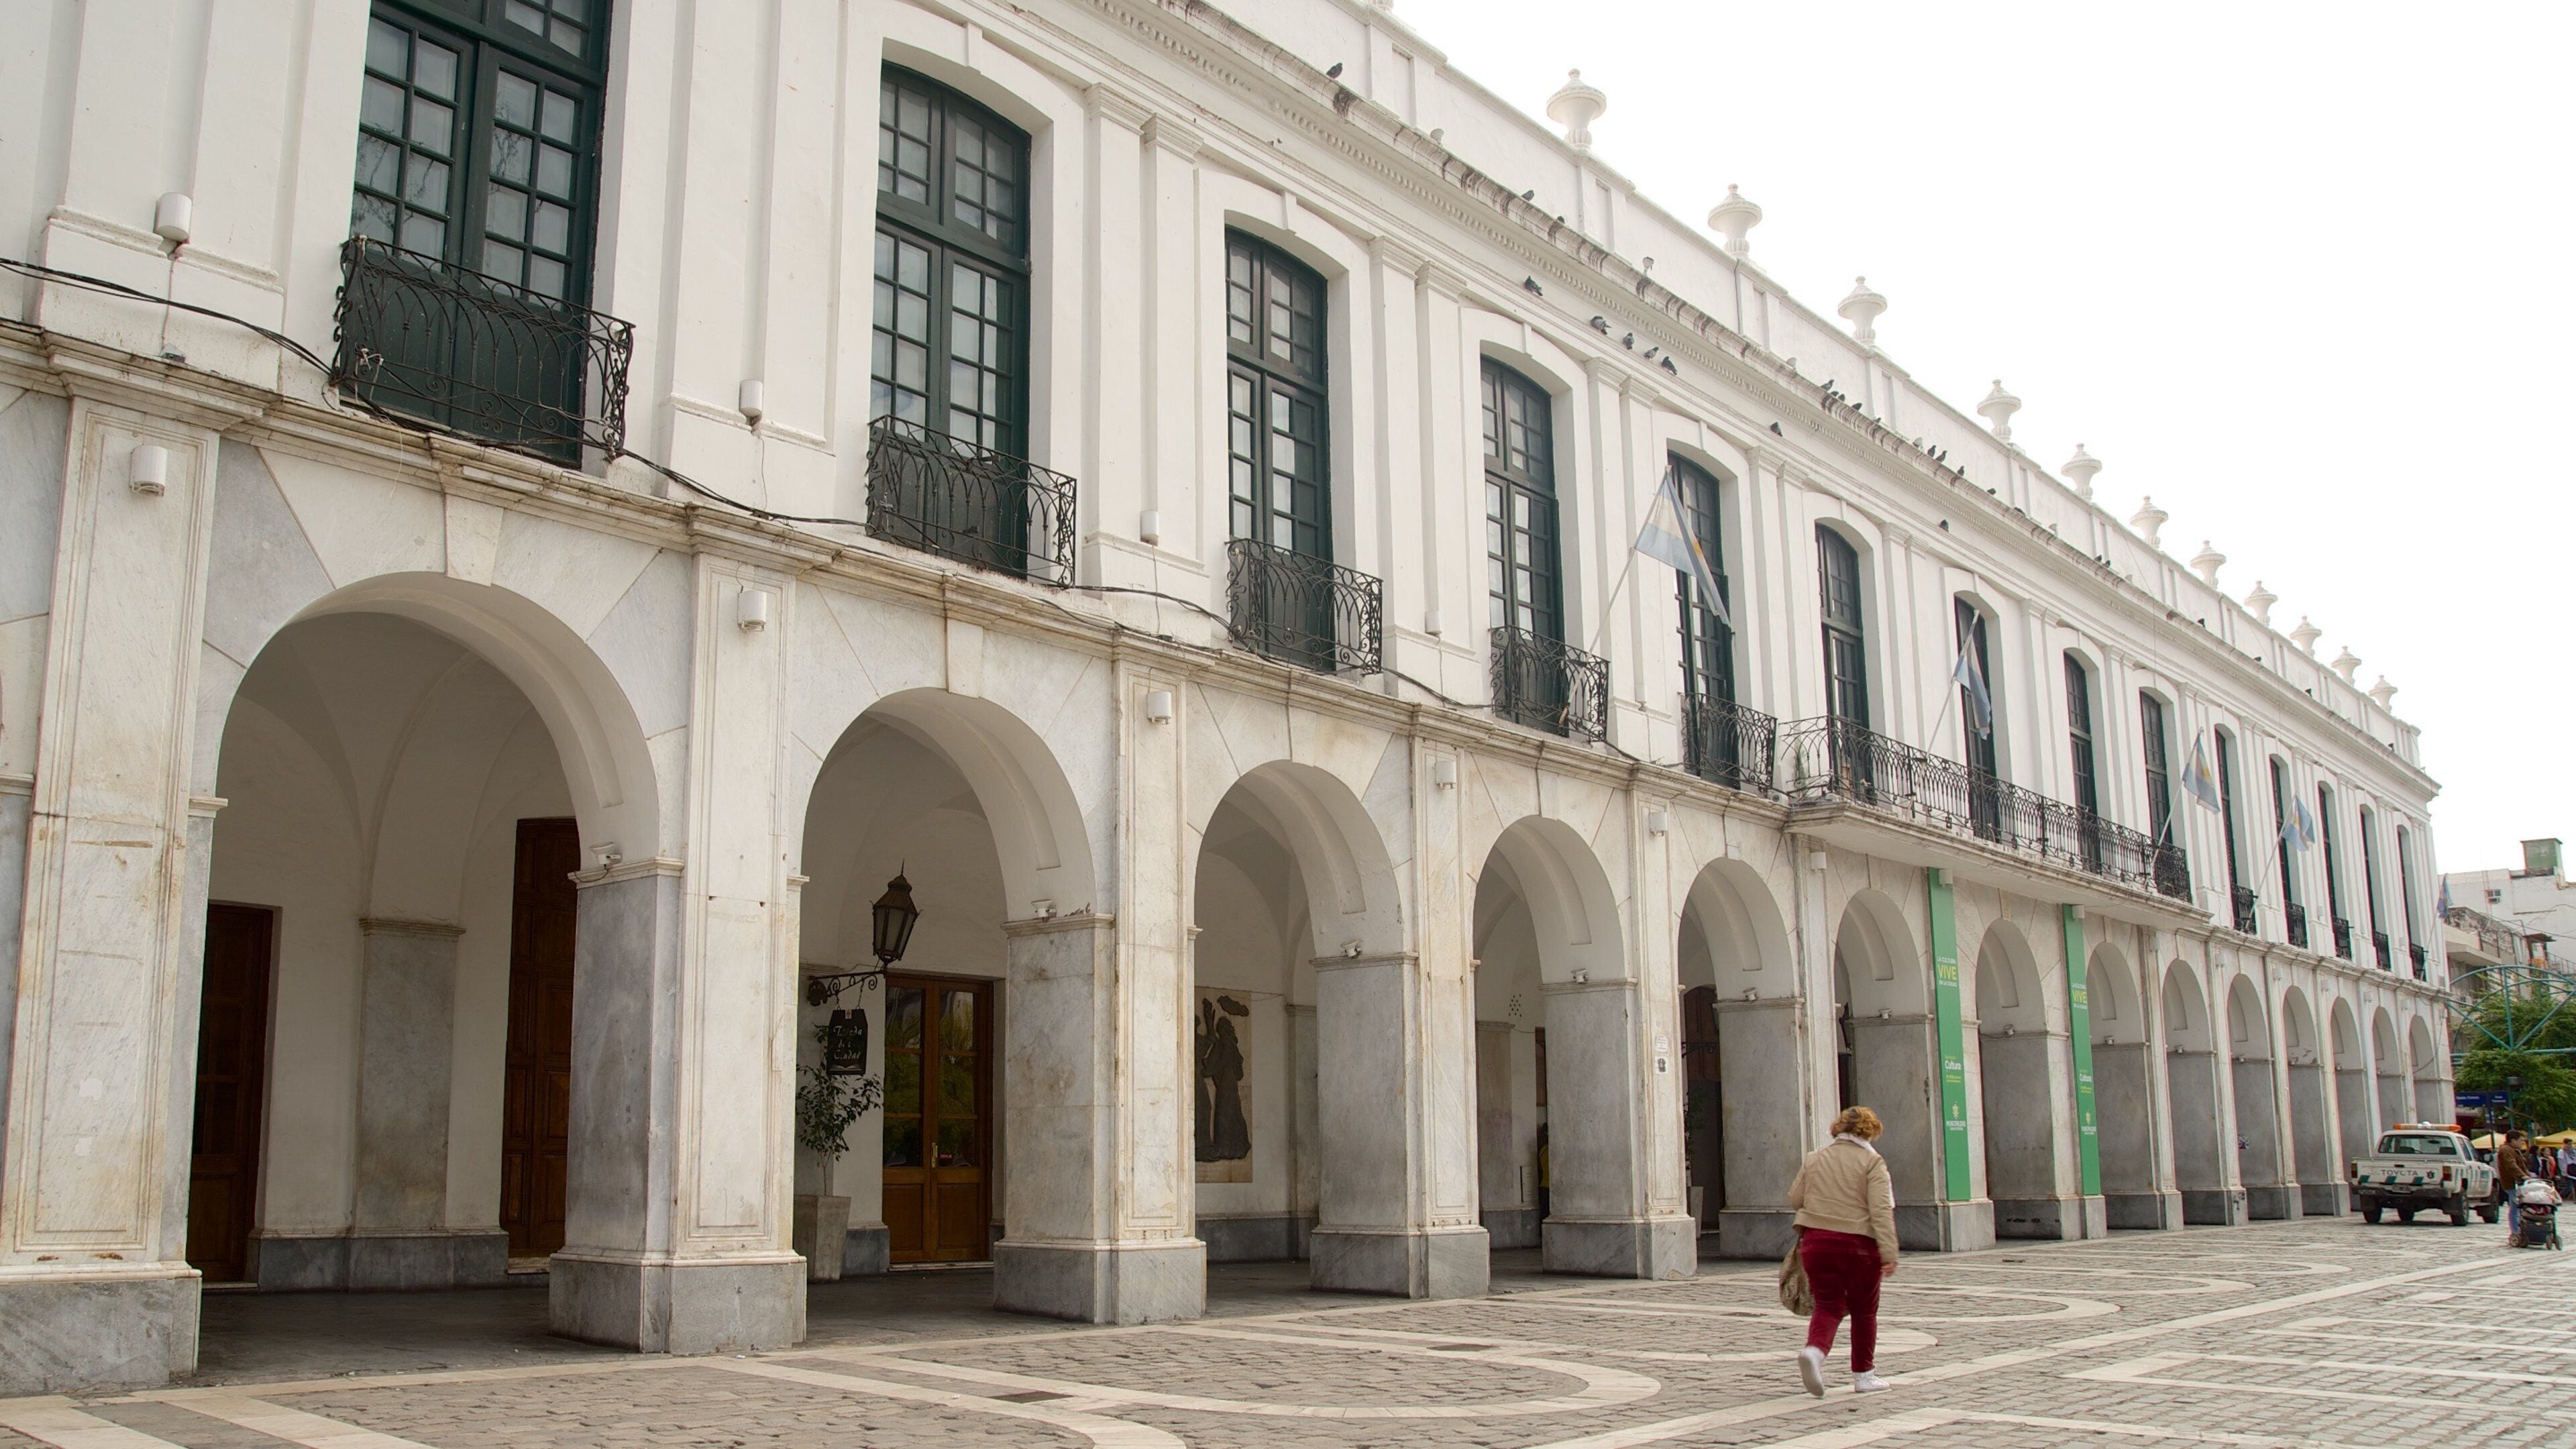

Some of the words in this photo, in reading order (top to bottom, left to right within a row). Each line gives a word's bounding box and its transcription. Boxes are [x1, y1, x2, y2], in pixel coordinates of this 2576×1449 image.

[1937, 964, 1957, 980] VIVE
[2072, 989, 2087, 1004] VIVE
[833, 1026, 863, 1036] Tnda
[1945, 1059, 1962, 1070] Cultura
